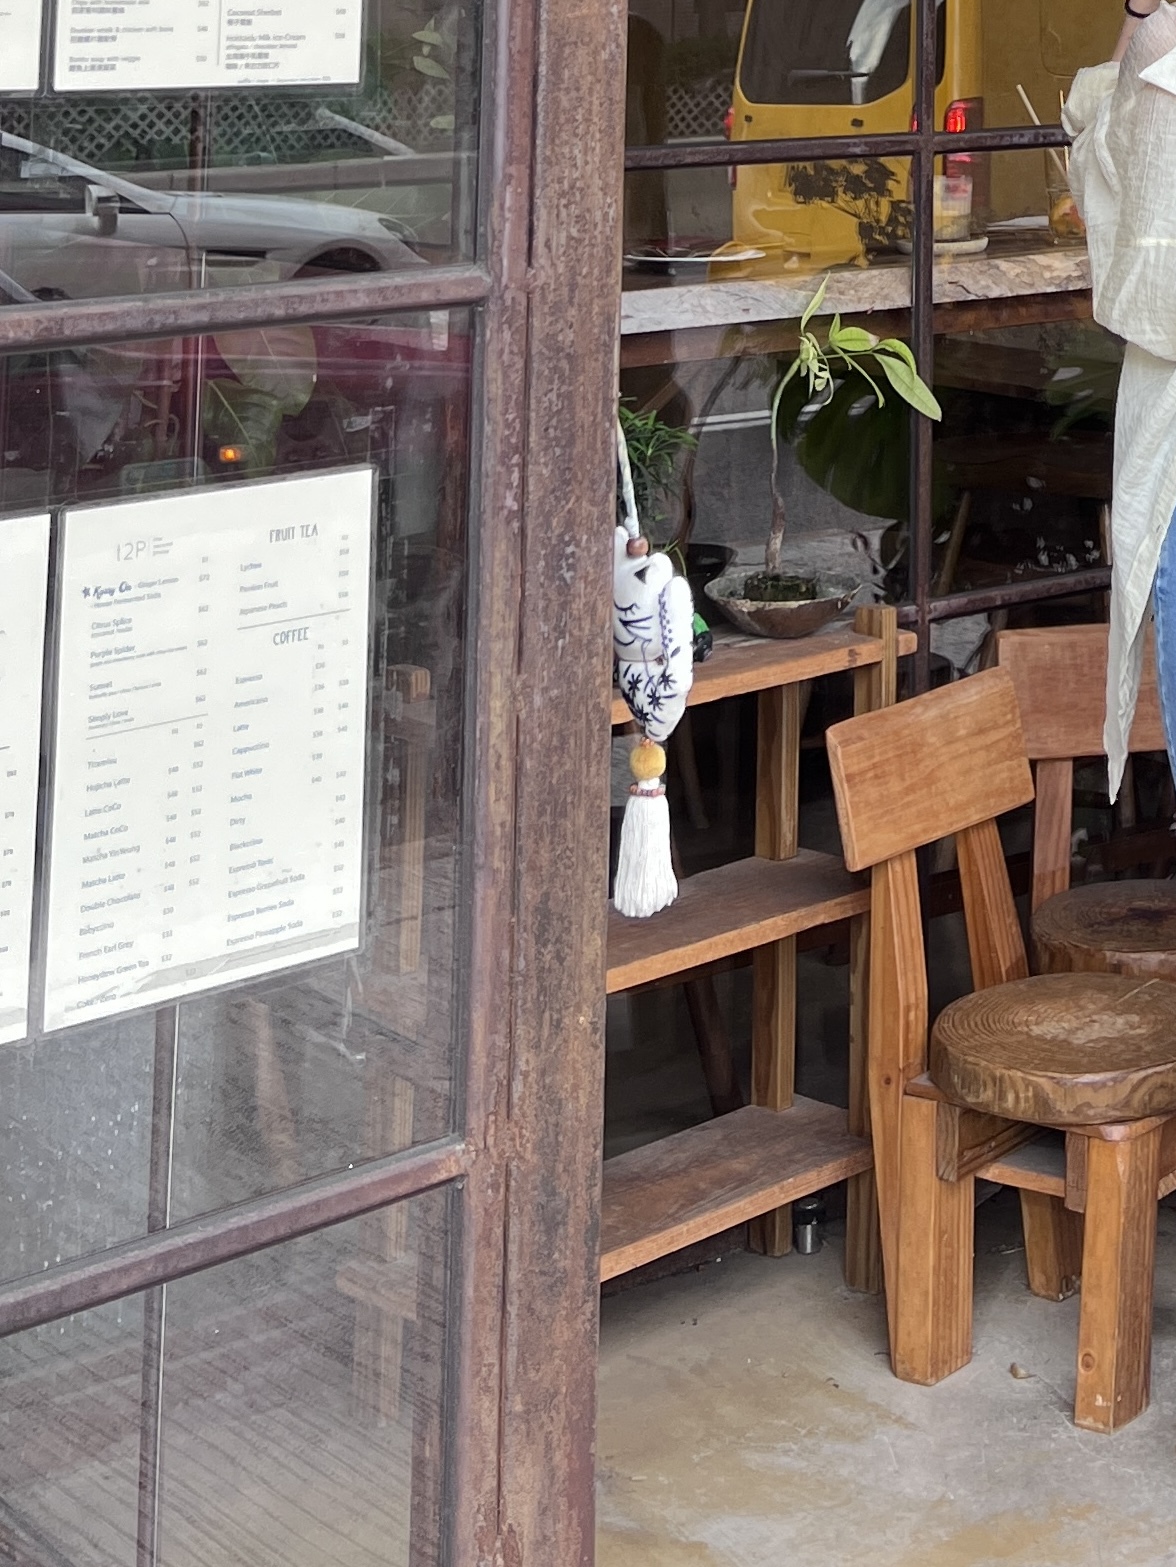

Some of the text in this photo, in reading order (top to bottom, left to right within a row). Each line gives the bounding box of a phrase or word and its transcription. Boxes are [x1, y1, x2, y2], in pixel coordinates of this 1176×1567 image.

[269, 523, 319, 543] FRUIT TEA
[272, 626, 309, 646] COFFEE
